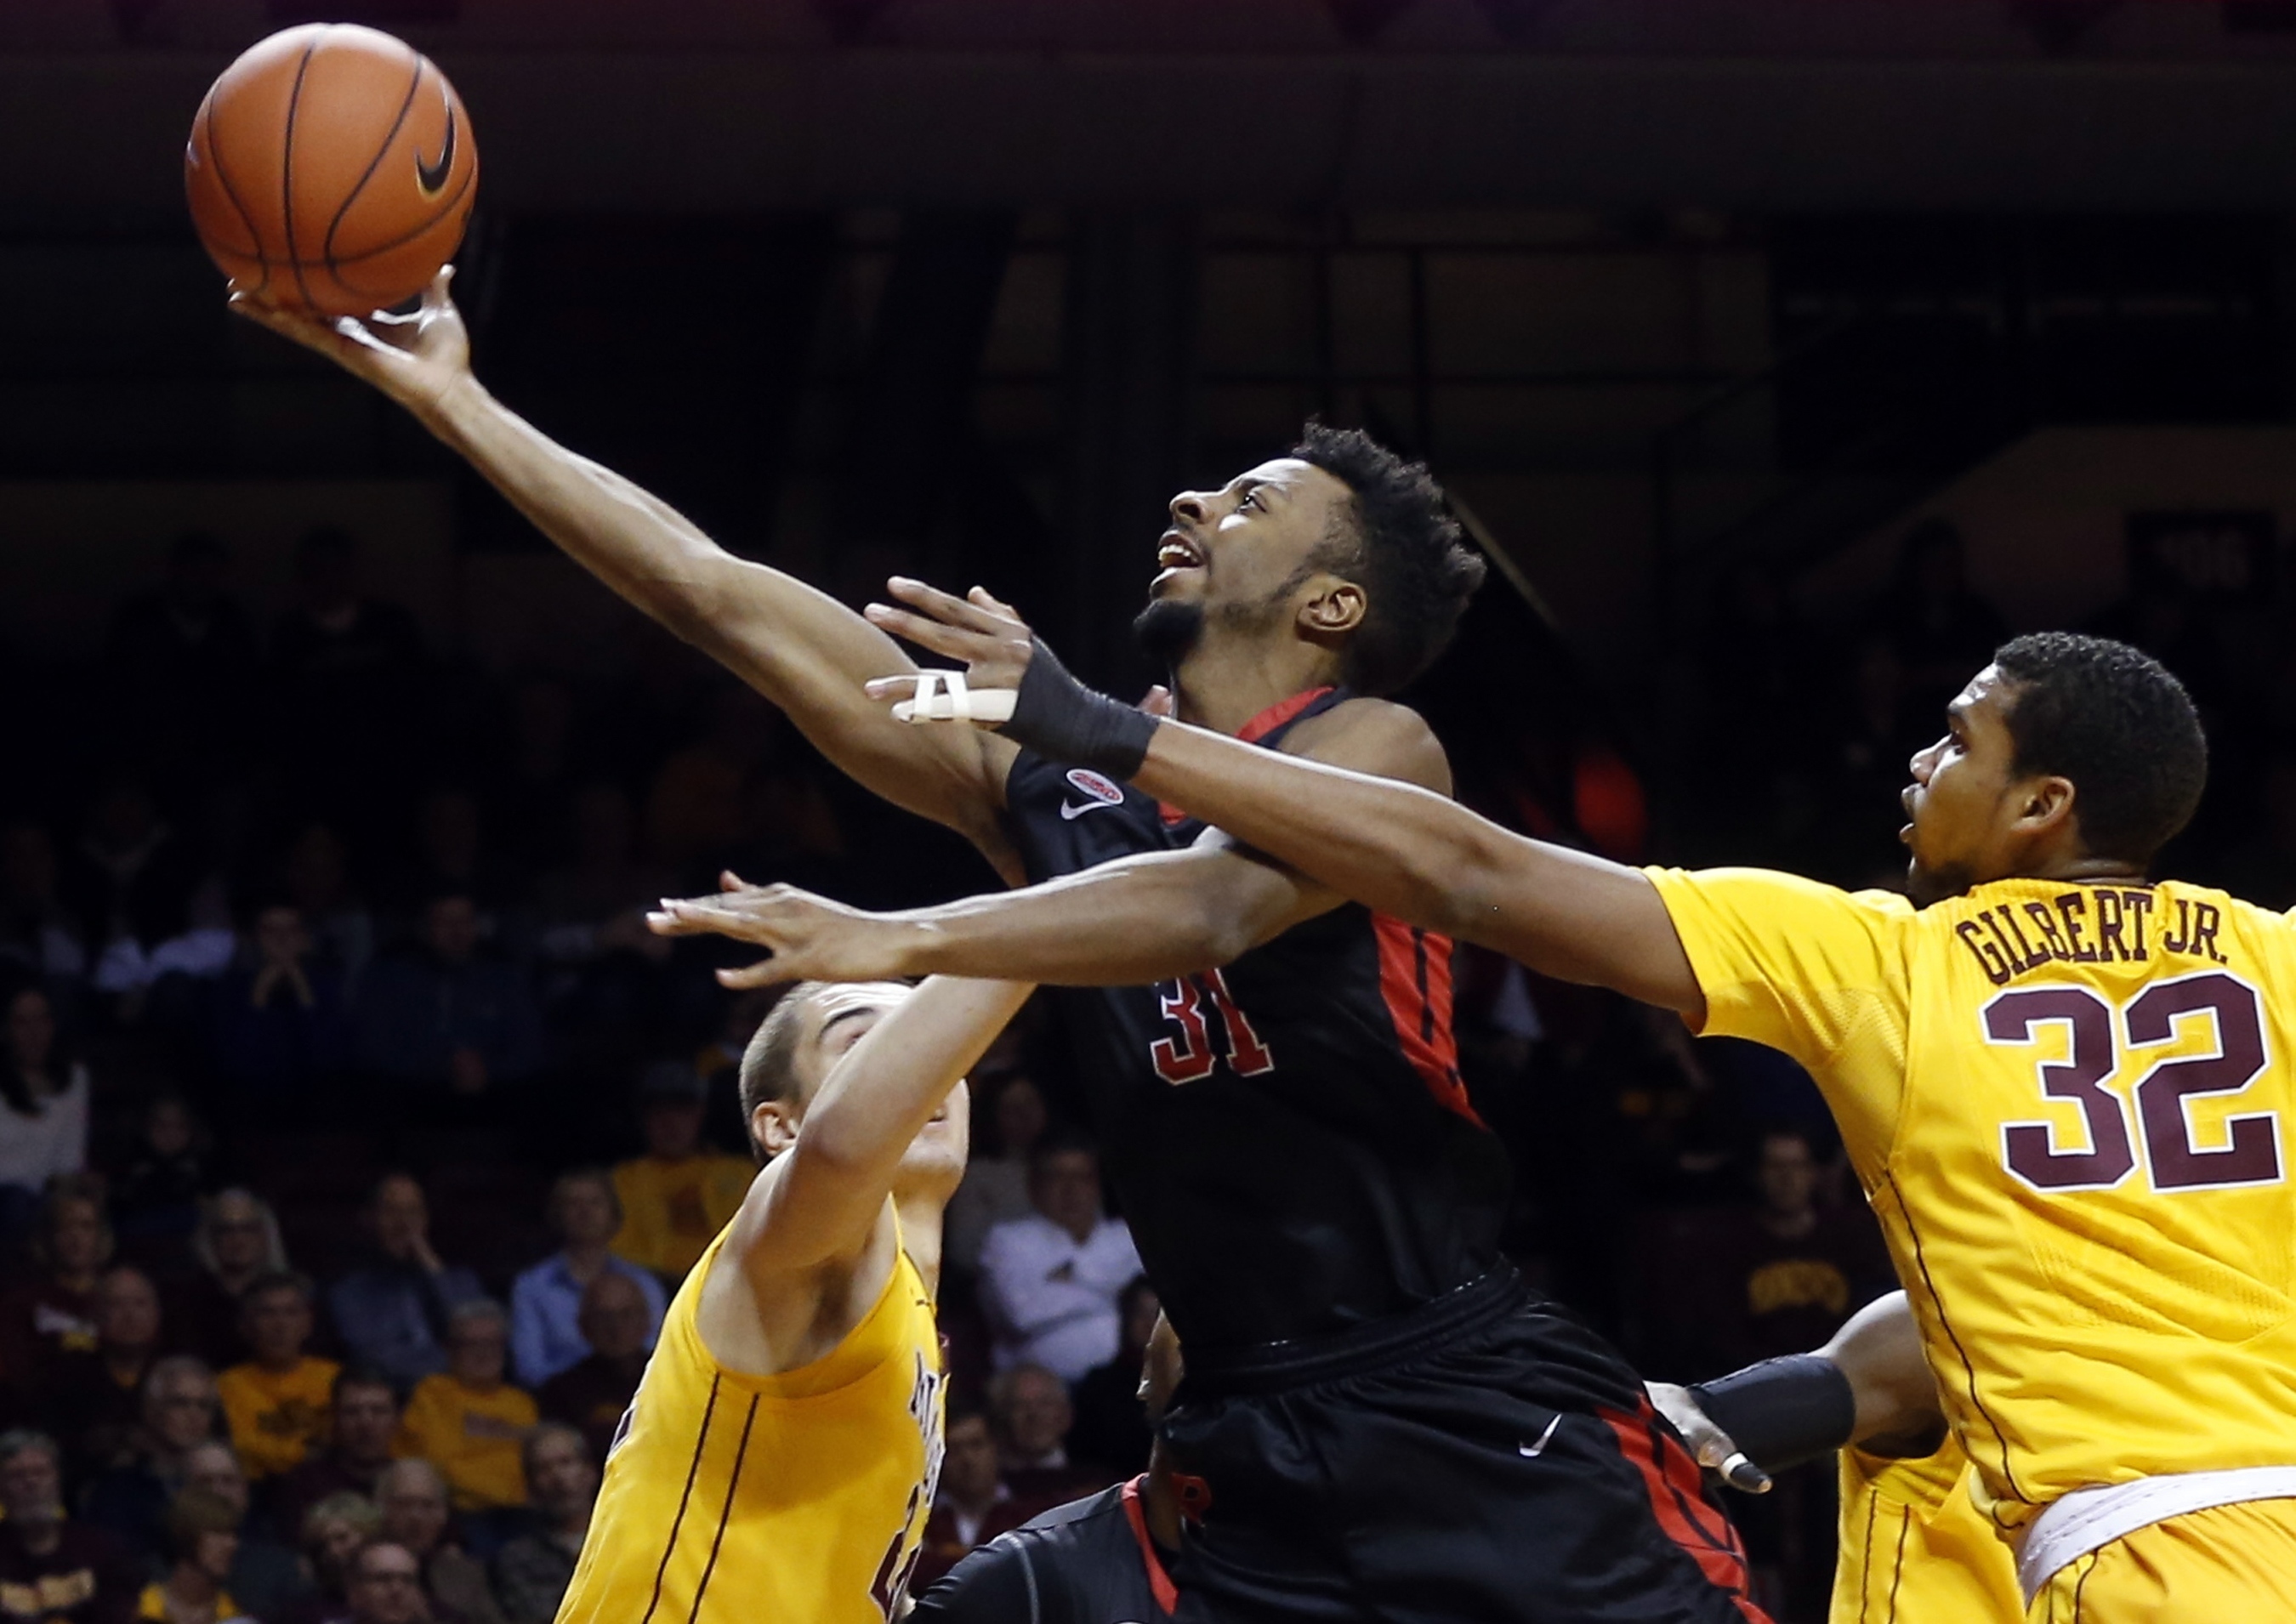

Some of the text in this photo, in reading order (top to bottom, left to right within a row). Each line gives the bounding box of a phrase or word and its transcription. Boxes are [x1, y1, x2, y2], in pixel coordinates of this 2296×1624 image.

[1956, 889, 2229, 986] GILBERT JR.
[1150, 967, 1274, 1086] 31
[1980, 969, 2285, 1191] 32
